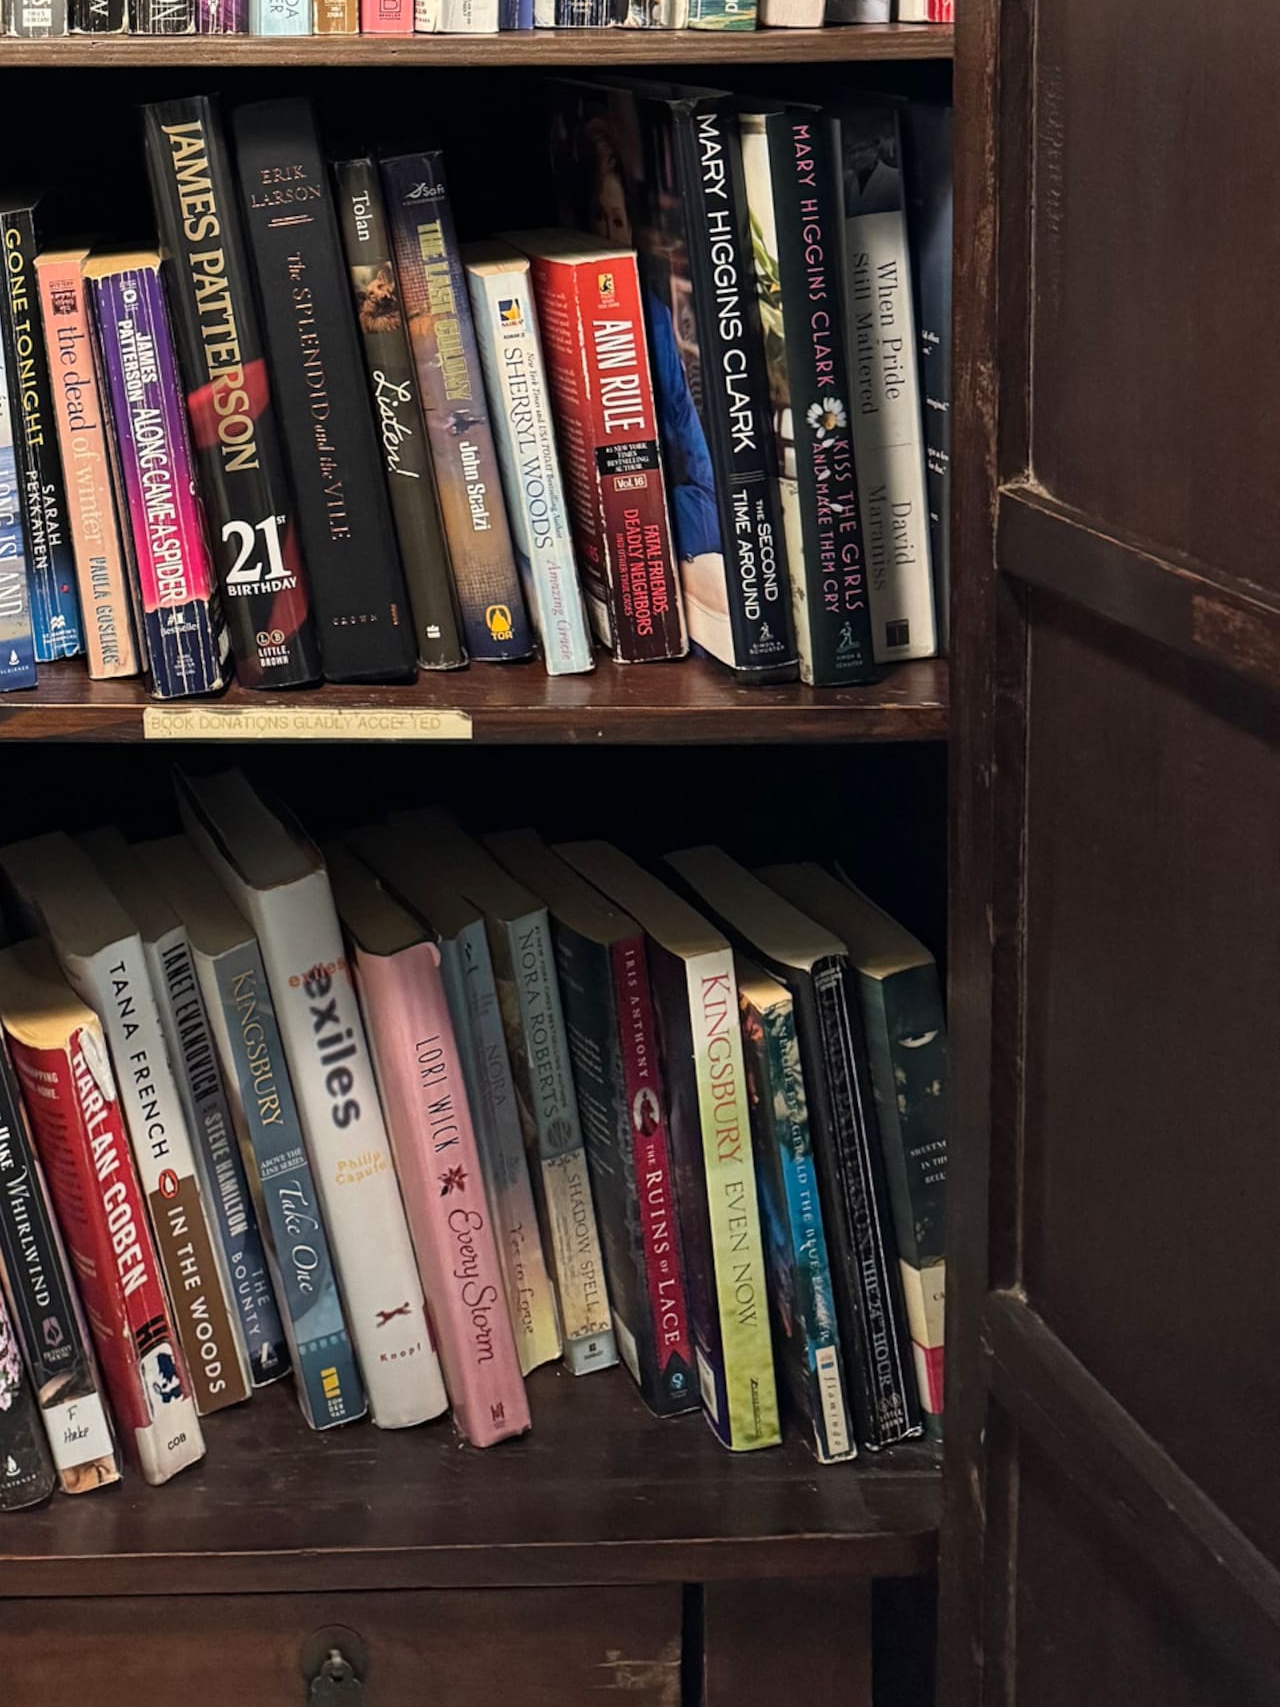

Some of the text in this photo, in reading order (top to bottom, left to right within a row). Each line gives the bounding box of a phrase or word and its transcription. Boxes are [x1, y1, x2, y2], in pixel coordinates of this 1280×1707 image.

[352, 190, 370, 242] Tolan
[791, 124, 836, 390] MARY HIGGINS CLARK
[6, 228, 46, 448] GONE TONIGHT
[162, 120, 260, 474] JAMES PATTERSON
[696, 114, 758, 455] MARY HIGGINS CLARK
[876, 260, 900, 402] When Pride
[135, 332, 158, 384] JAMES
[592, 319, 645, 435] ANN RULE
[503, 347, 555, 550] SHERRYL WOODS
[24, 470, 49, 570] PEKKANEN
[40, 484, 62, 547] SARAH
[221, 516, 294, 583] 21
[730, 490, 760, 620] TIME AROUND
[754, 498, 778, 602] THE SECOND
[892, 501, 916, 566] David
[227, 576, 298, 596] BIRTHDAY
[151, 716, 193, 730] BOOK
[199, 716, 288, 731] DONATIONS
[294, 716, 353, 730] GLADLY
[109, 960, 169, 1161] TANA FRENCH
[231, 969, 285, 1128] KINGSBURY
[518, 927, 560, 1120] NORA ROBERTS
[700, 970, 745, 1166] KINGSBURY
[415, 1035, 461, 1155] LORI WICK
[166, 1205, 227, 1395] IN THE WOODS
[231, 1251, 260, 1336] BOUNTY
[724, 1180, 758, 1330] EVEN NOW
